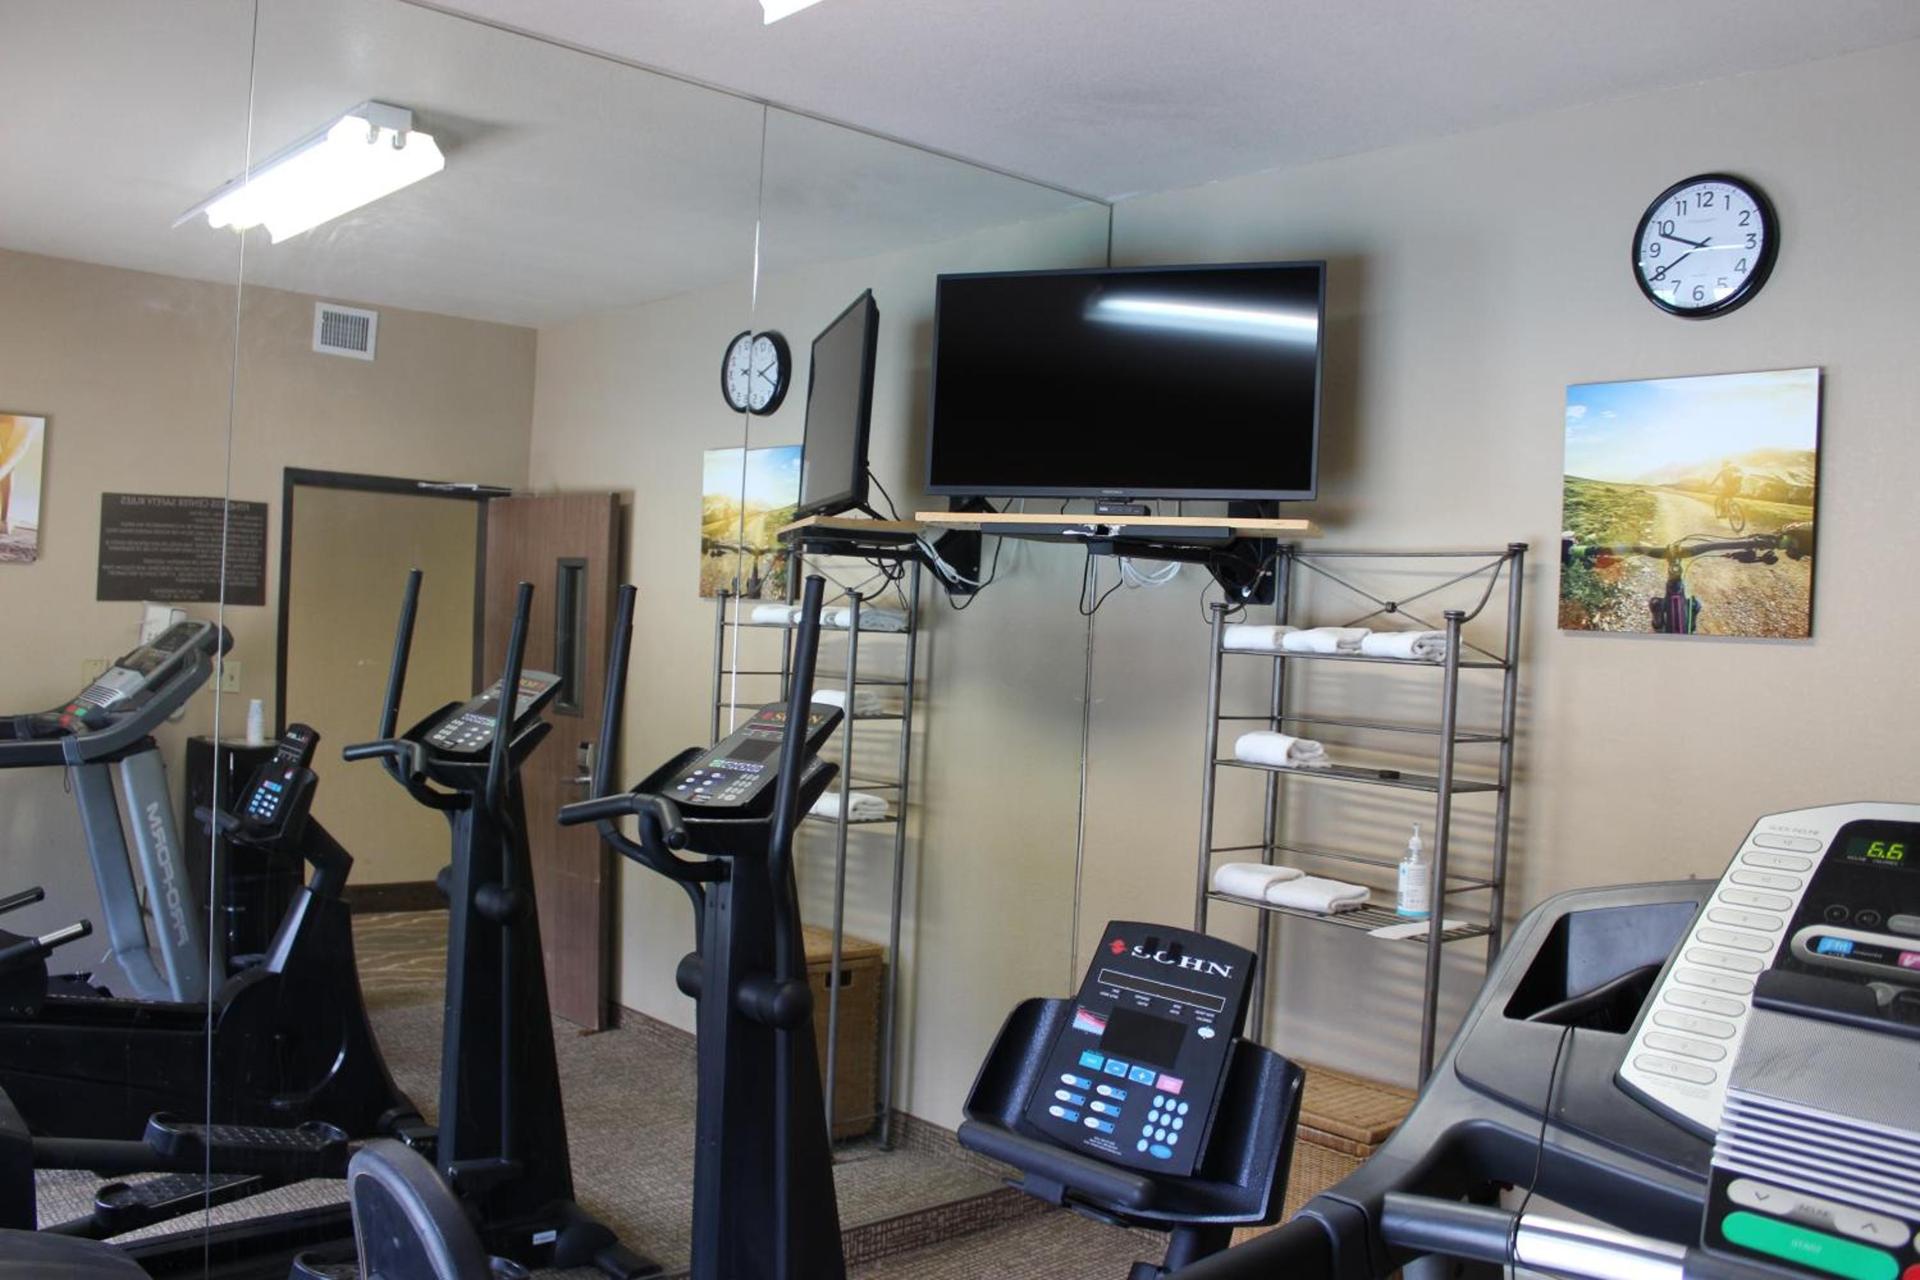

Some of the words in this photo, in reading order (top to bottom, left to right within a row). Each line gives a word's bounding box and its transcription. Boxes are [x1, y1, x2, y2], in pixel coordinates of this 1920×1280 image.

[1697, 191, 1714, 208] 12
[1724, 195, 1730, 210] 1
[1676, 200, 1687, 216] 11
[1738, 210, 1750, 226] 2
[1657, 219, 1675, 236] 10
[1745, 233, 1757, 249] 3
[1649, 242, 1661, 258] 9
[1654, 266, 1667, 281] 8
[1734, 258, 1747, 274] 4
[1671, 280, 1682, 295] 7
[1717, 277, 1728, 290] 5
[1693, 284, 1705, 301] 6
[1867, 841, 1904, 860] 6.6
